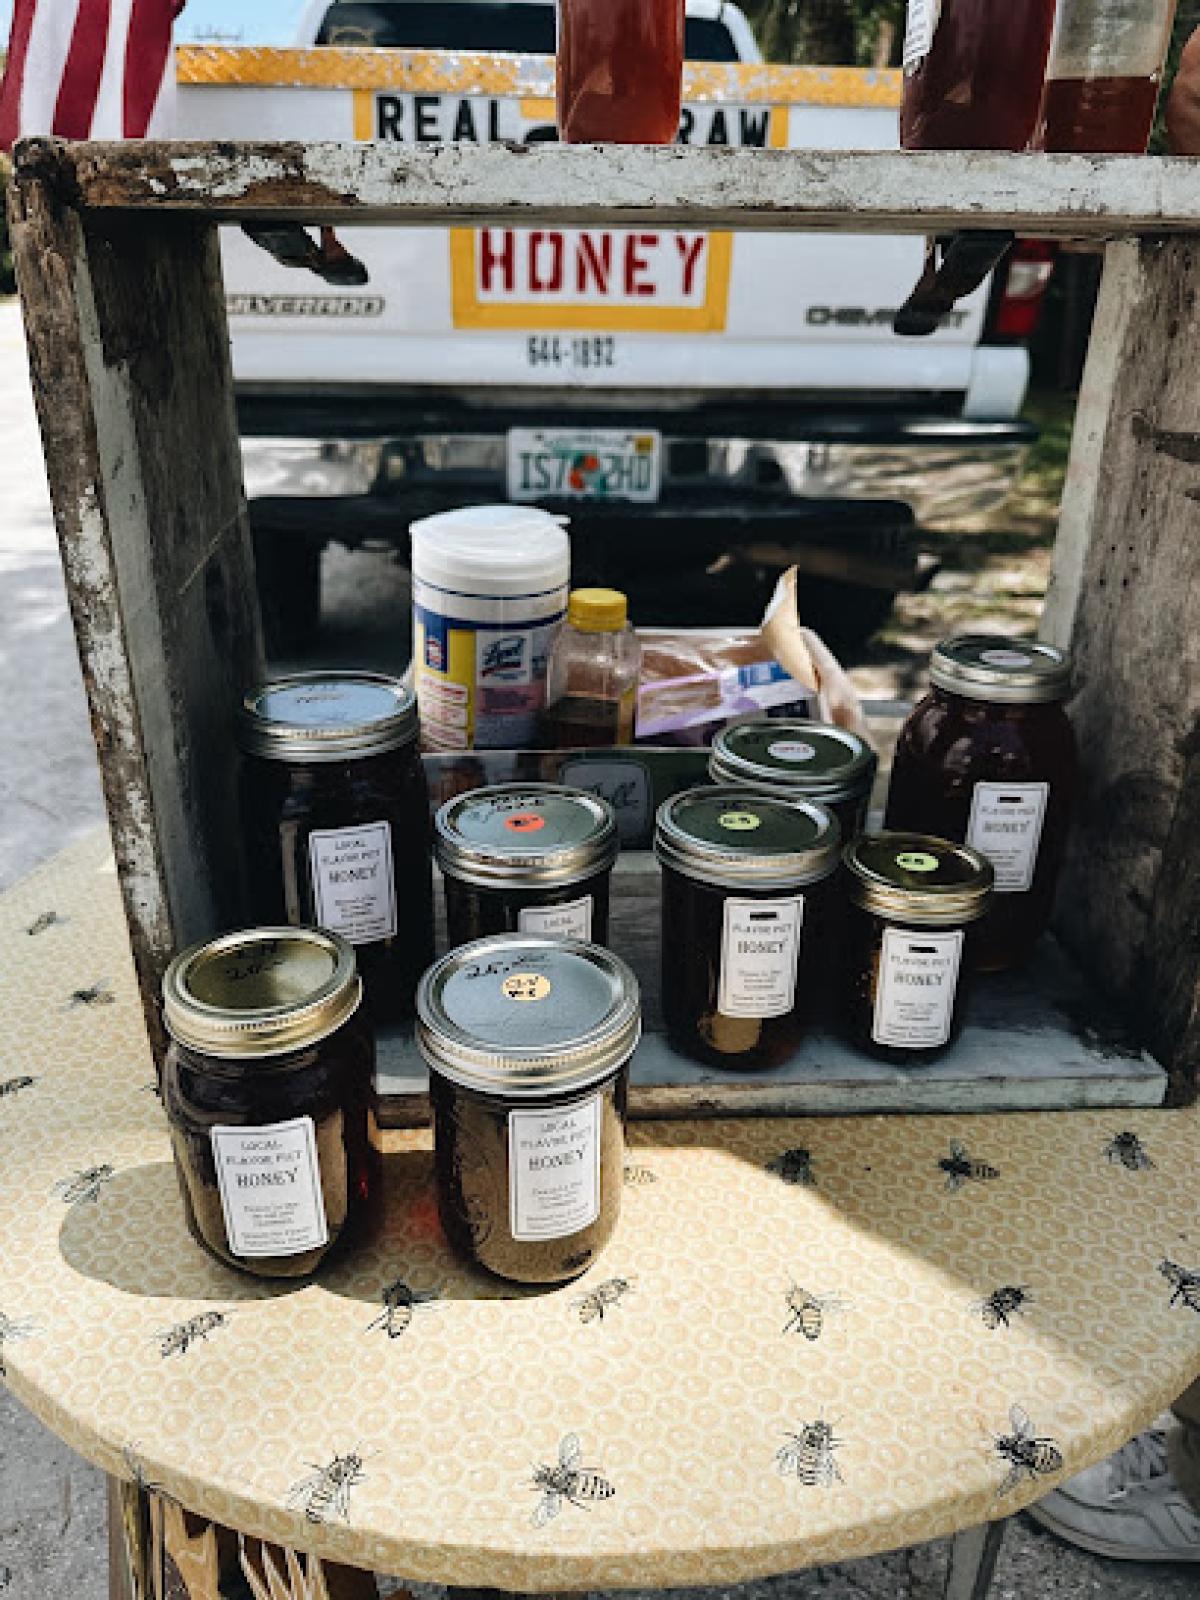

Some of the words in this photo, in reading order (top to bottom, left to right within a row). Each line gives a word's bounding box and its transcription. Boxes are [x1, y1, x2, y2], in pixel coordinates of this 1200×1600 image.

[376, 96, 503, 142] REAL
[678, 108, 770, 147] RAW
[480, 226, 704, 296] HONEY
[527, 334, 614, 368] 644-1892
[329, 862, 378, 883] HONEY
[737, 937, 789, 954] HONEY
[893, 971, 945, 986] HONEY
[540, 1119, 577, 1133] LOCAL
[241, 1140, 283, 1151] LOCAL
[529, 1143, 587, 1172] HONEY
[236, 1167, 298, 1188] HONEY
